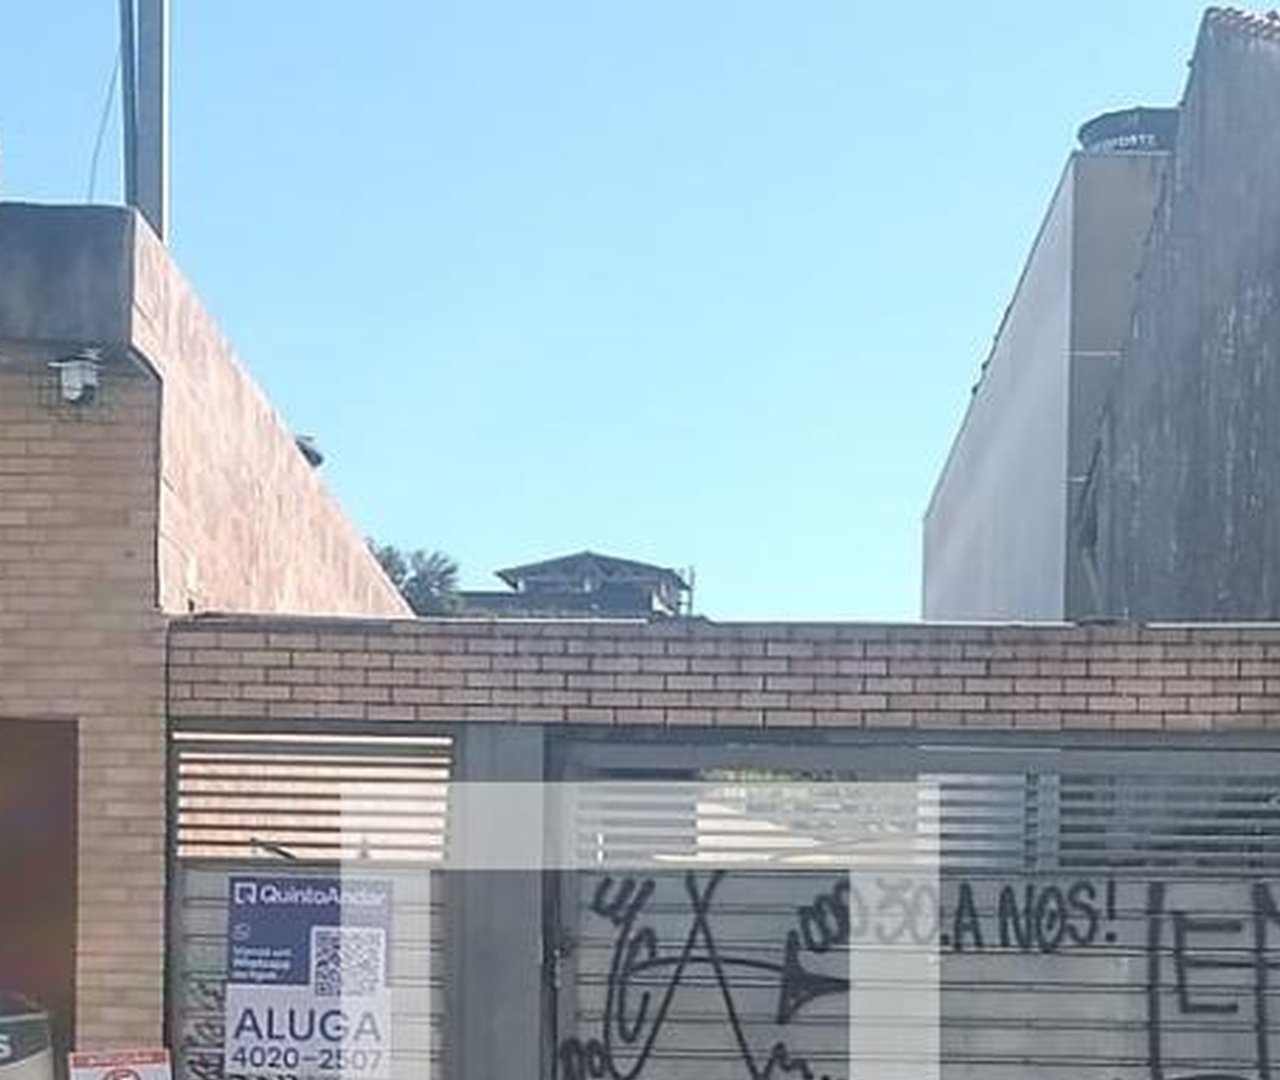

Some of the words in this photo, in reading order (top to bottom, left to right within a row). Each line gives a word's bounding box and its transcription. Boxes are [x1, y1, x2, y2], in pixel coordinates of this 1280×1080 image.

[260, 884, 387, 905] QuintoAndar
[233, 1008, 382, 1042] ALUGA
[231, 1046, 383, 1070] 4020-2507
